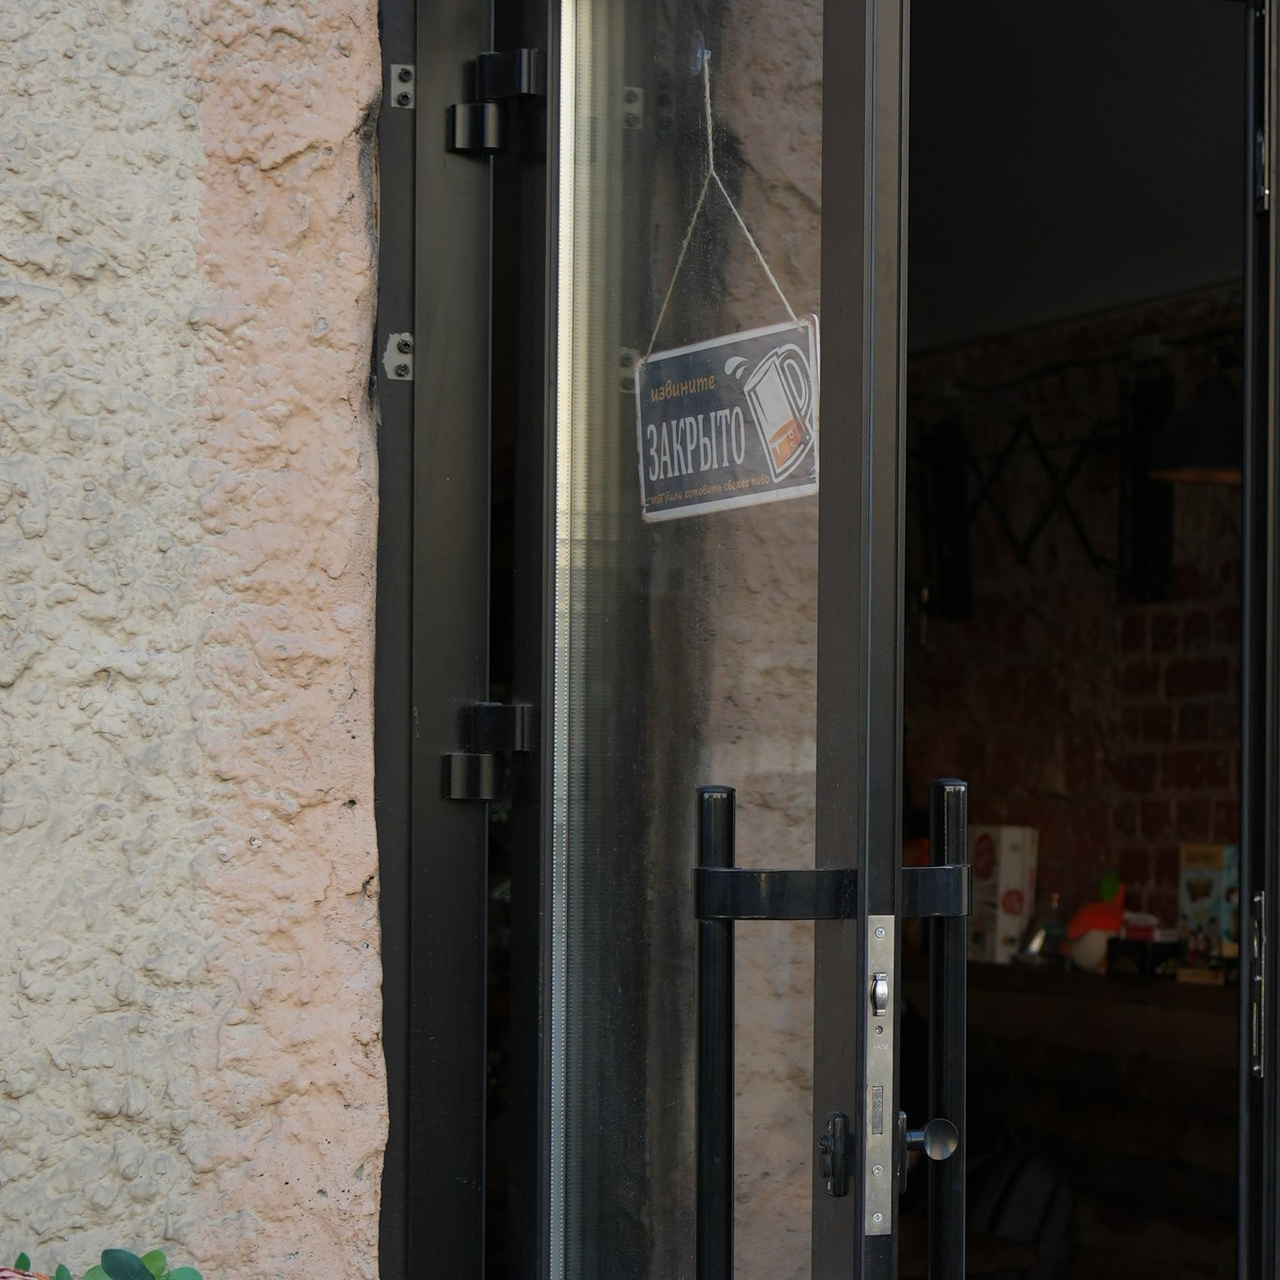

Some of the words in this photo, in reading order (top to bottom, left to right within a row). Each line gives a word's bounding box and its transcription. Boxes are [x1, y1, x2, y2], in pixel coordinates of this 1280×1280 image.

[650, 375, 716, 402] извините
[646, 406, 746, 482] ЗАКРЫТО
[684, 483, 723, 500] готовить
[724, 479, 750, 492] свежее
[751, 473, 770, 488] пиво
